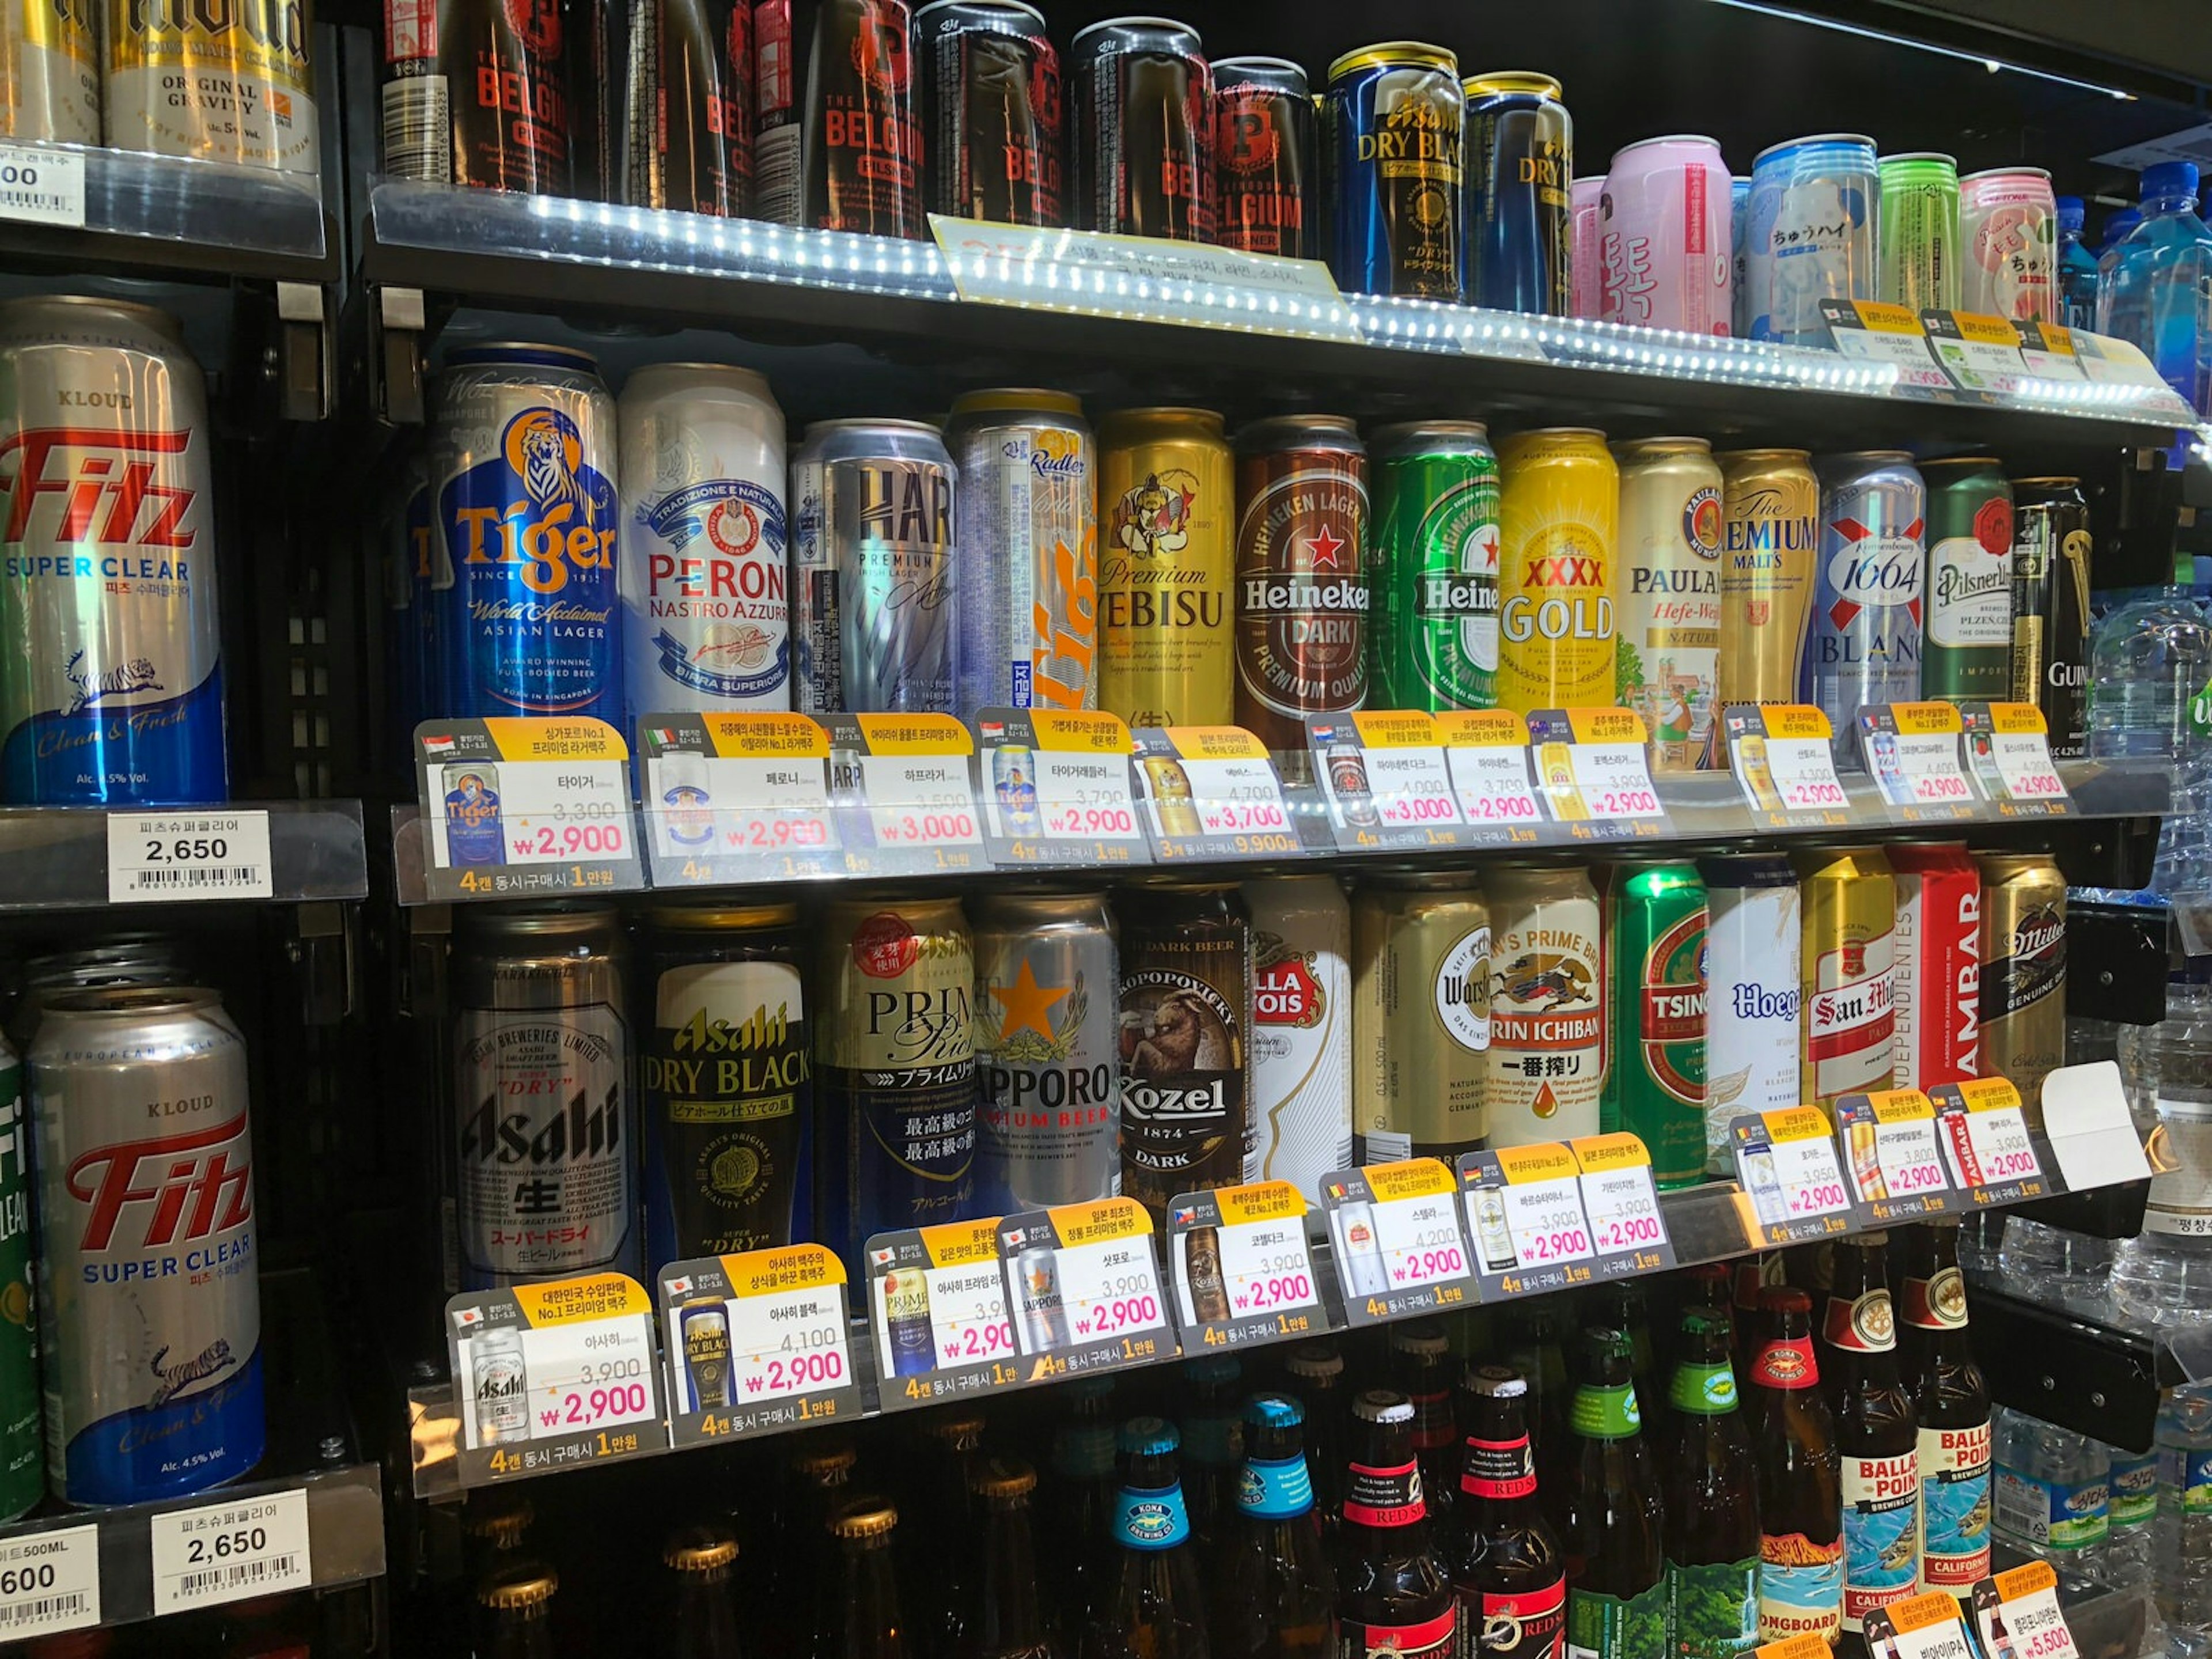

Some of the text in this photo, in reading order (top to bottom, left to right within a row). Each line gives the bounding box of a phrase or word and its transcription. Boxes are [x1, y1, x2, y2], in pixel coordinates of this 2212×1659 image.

[162, 75, 257, 100] ORIGINAL
[168, 94, 254, 115] GRAVITY
[1358, 132, 1411, 162] DRY
[1519, 157, 1561, 185] DRY
[1772, 222, 1846, 246] ちゅうハイ
[59, 390, 132, 410] KLOUD
[1031, 449, 1085, 476] Radler
[0, 427, 198, 548] Fitz
[1253, 494, 1316, 556] HEINEKEN
[455, 501, 616, 594] Tiger
[6, 557, 189, 581] SUPER CLEAR
[859, 554, 931, 569] PREMIUM
[1103, 558, 1207, 586] Premium
[1523, 558, 1604, 588] XXXX
[1843, 553, 1920, 592] 1664
[467, 599, 522, 622] World
[651, 600, 728, 618] NASTRO
[1502, 596, 1613, 642] GOLD
[484, 625, 604, 638] ASIAN LAGER
[1292, 621, 1350, 643] DARK
[675, 666, 785, 691] BIRRA SUPERIORE
[1253, 647, 1325, 699] PREMIUM
[546, 728, 604, 740] 싱가포르 No.1
[532, 741, 606, 754] 프리미엄 라거맥주
[558, 775, 593, 789] 타이거
[766, 772, 798, 785] 페로니
[904, 770, 945, 782] 하프라거
[554, 802, 615, 822] 3,300
[140, 820, 238, 833] 피츠슈퍼클리어
[146, 839, 227, 863] 2,650
[460, 866, 614, 892] 4캔 1만원
[1195, 940, 1235, 952] BEER
[1527, 931, 1582, 950] PRIME
[2016, 922, 2066, 956] Miller
[1957, 892, 1980, 1077] AMBAR
[2007, 979, 2054, 1009] GENUINE
[1815, 994, 1863, 1027] San
[673, 1001, 787, 1053] Asahi
[497, 1029, 600, 1063] BREWERIES LIMITED
[646, 1049, 811, 1094] DRY BLACK
[1501, 1054, 1581, 1077] 一番搾り
[147, 1095, 213, 1118] KLOUD
[1059, 1107, 1108, 1127] BEER
[462, 1081, 620, 1165] Asahi
[1142, 1127, 1183, 1139] 1874
[1135, 1149, 1190, 1168] DARK
[66, 1107, 252, 1253] Fitz
[514, 1179, 561, 1215] 生
[1092, 1206, 1133, 1224] 일본 최초의
[1412, 1207, 1437, 1221] 스텔라
[491, 1225, 589, 1245] スーパードライ
[1086, 1224, 1118, 1239] 프리미엄
[1119, 1220, 1135, 1233] 맥주
[1251, 1232, 1284, 1247] 코젤다크
[1416, 1227, 1456, 1249] 4,200
[84, 1235, 250, 1284] SUPER CLEAR
[769, 1252, 824, 1271] 아사히 맥주의
[1103, 1252, 1129, 1267] 삿포로
[1260, 1253, 1304, 1275] 3,900
[750, 1267, 825, 1290] 상식을 바꾼 흑맥주
[938, 1277, 988, 1295] 아사히 프라임
[1102, 1274, 1149, 1297] 3,900
[543, 1281, 627, 1305] 대한민국 수입판매
[539, 1296, 628, 1320] No.1 프리미엄 맥주
[770, 1302, 817, 1321] 아사히 블랙
[585, 1332, 620, 1350] 아사히
[781, 1327, 836, 1353] 4,100
[581, 1358, 641, 1385] 3,900
[702, 1398, 836, 1437] 4캔 동시 구매시 1만원
[490, 1431, 638, 1474] 4캔 동시 구매시 1만원
[1494, 1482, 1524, 1494] RED
[181, 1505, 277, 1533] 피츠슈퍼클리어
[1139, 1505, 1163, 1514] KONA
[1376, 1510, 1408, 1523] RED
[187, 1527, 267, 1564] 2,650
[1525, 1621, 1555, 1638] RED
